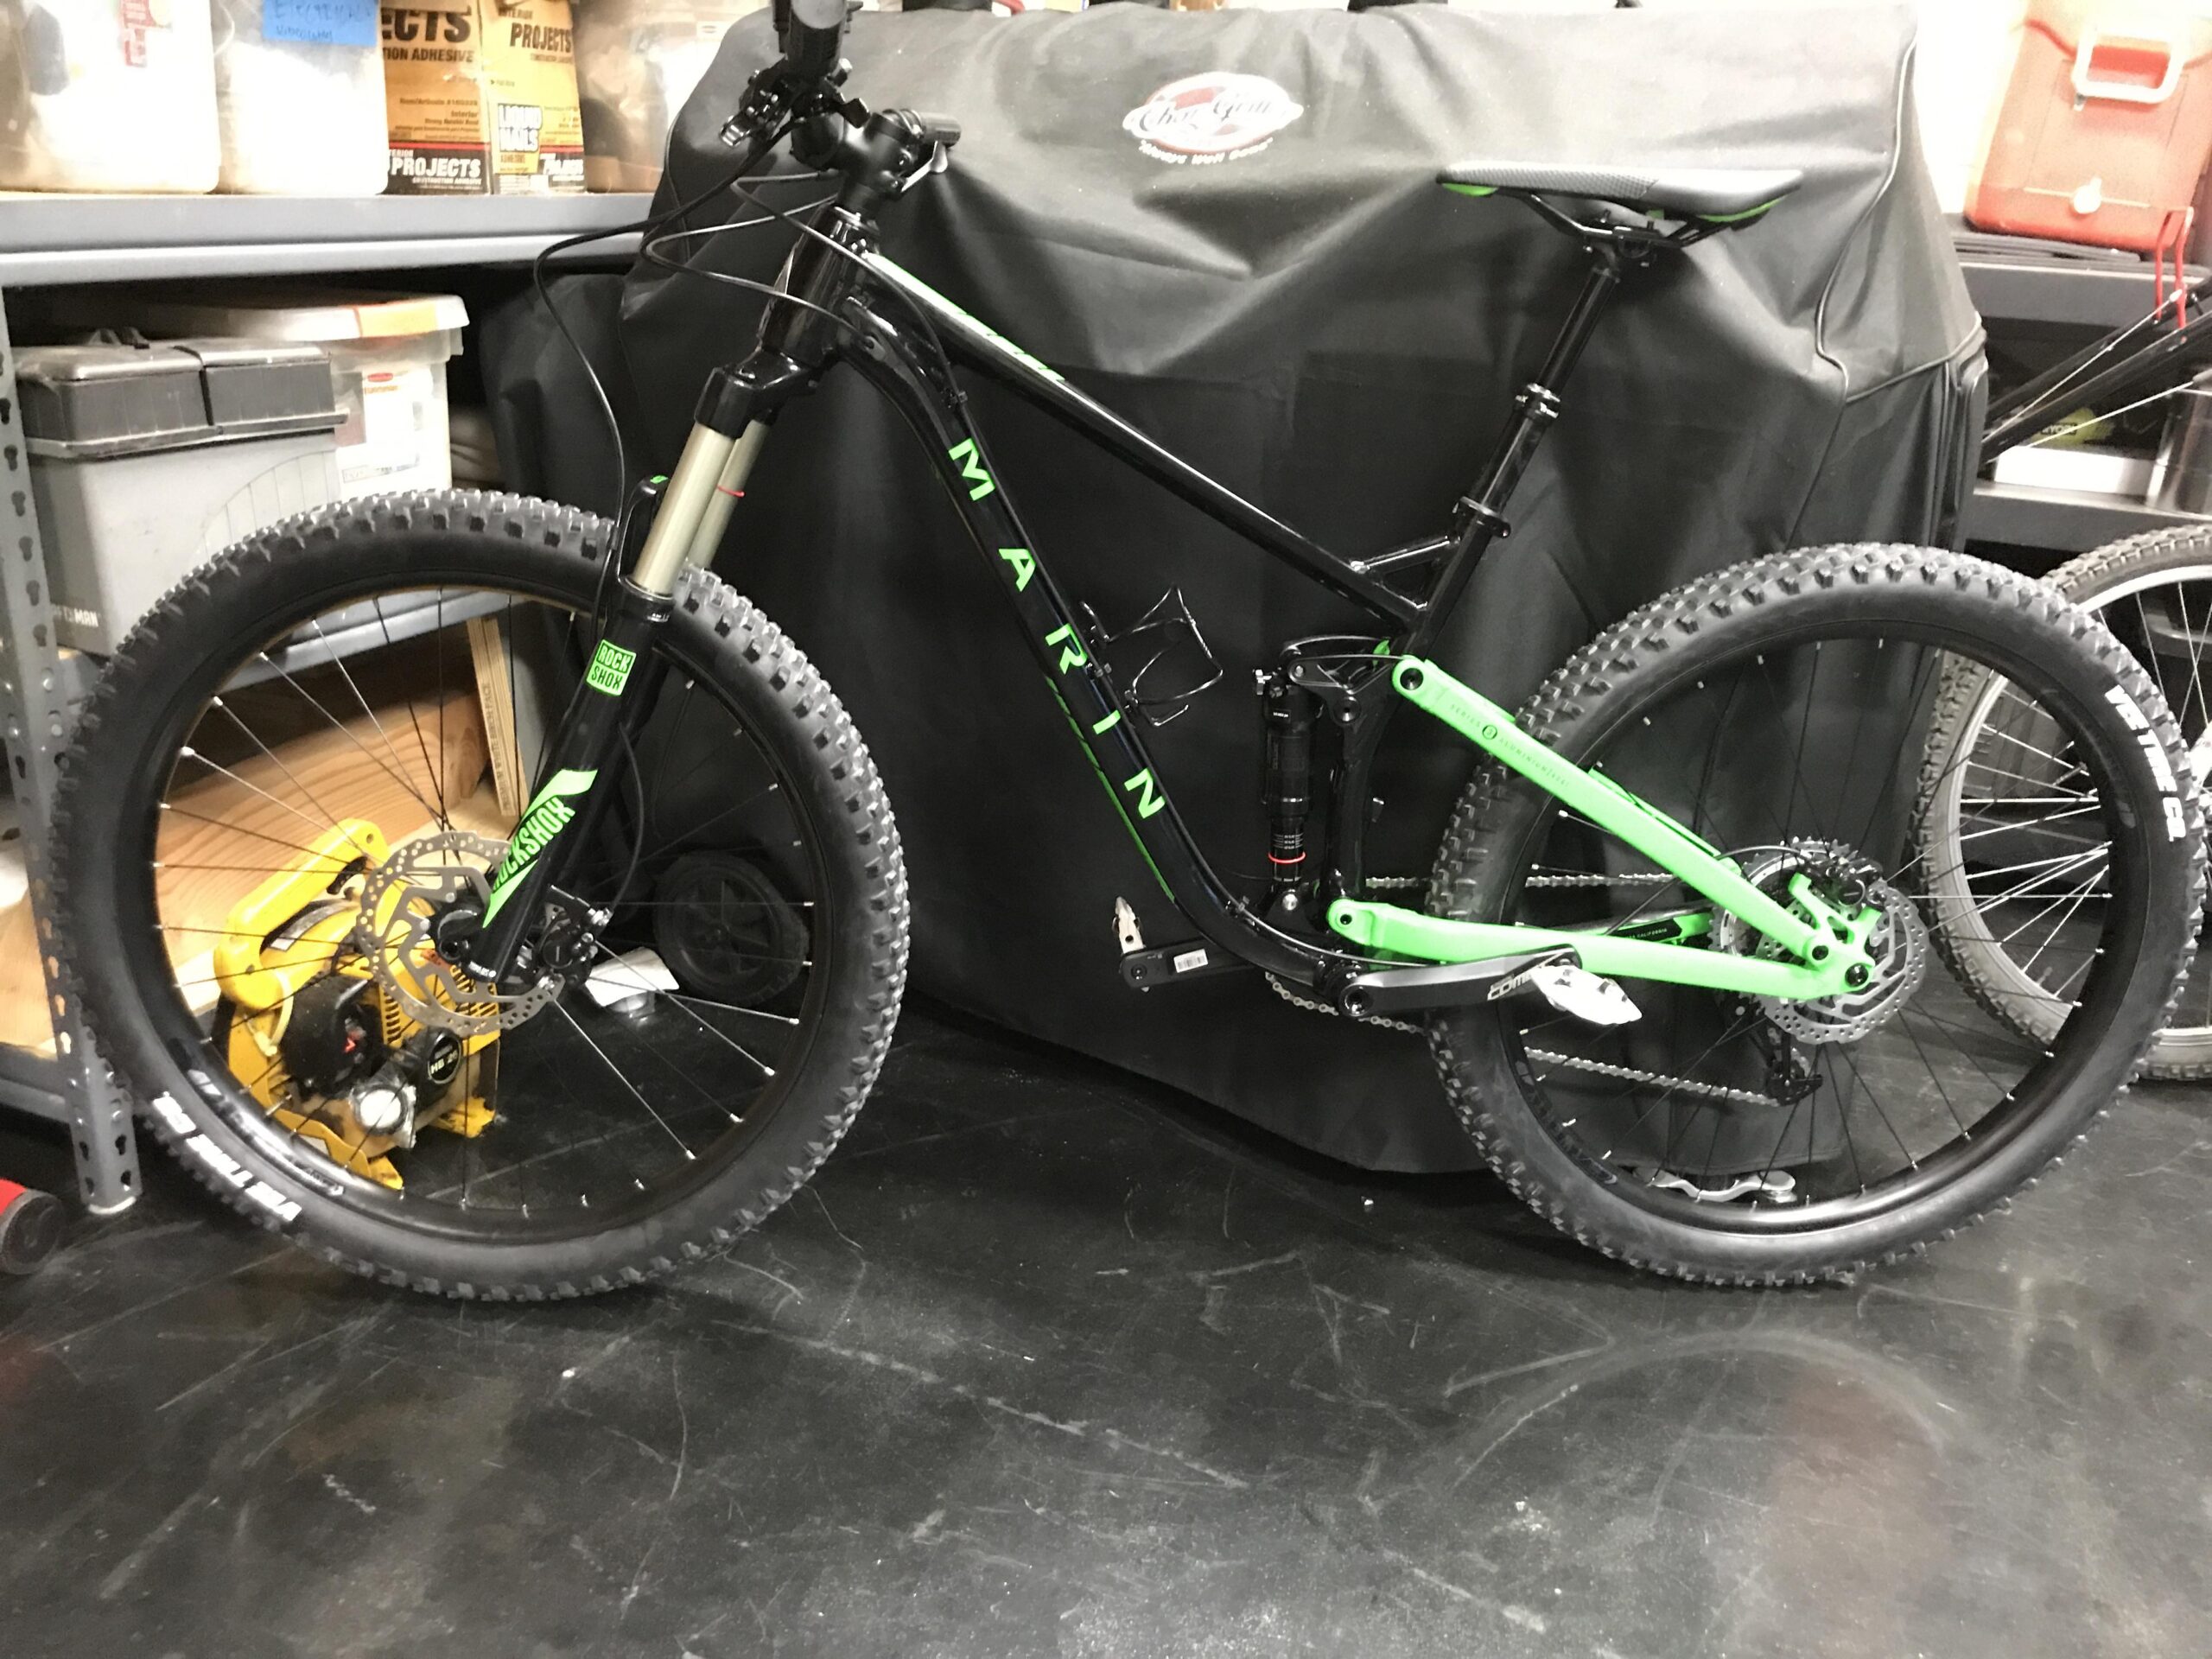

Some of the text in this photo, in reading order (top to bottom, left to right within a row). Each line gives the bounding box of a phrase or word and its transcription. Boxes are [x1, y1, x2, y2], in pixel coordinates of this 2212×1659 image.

[510, 22, 572, 53] PROJECTS
[411, 48, 474, 62] ADHESIVE
[390, 157, 481, 178] PROJECTS
[949, 437, 1166, 819] MARIN
[598, 645, 632, 672] ROCK
[592, 664, 623, 690] SHOX
